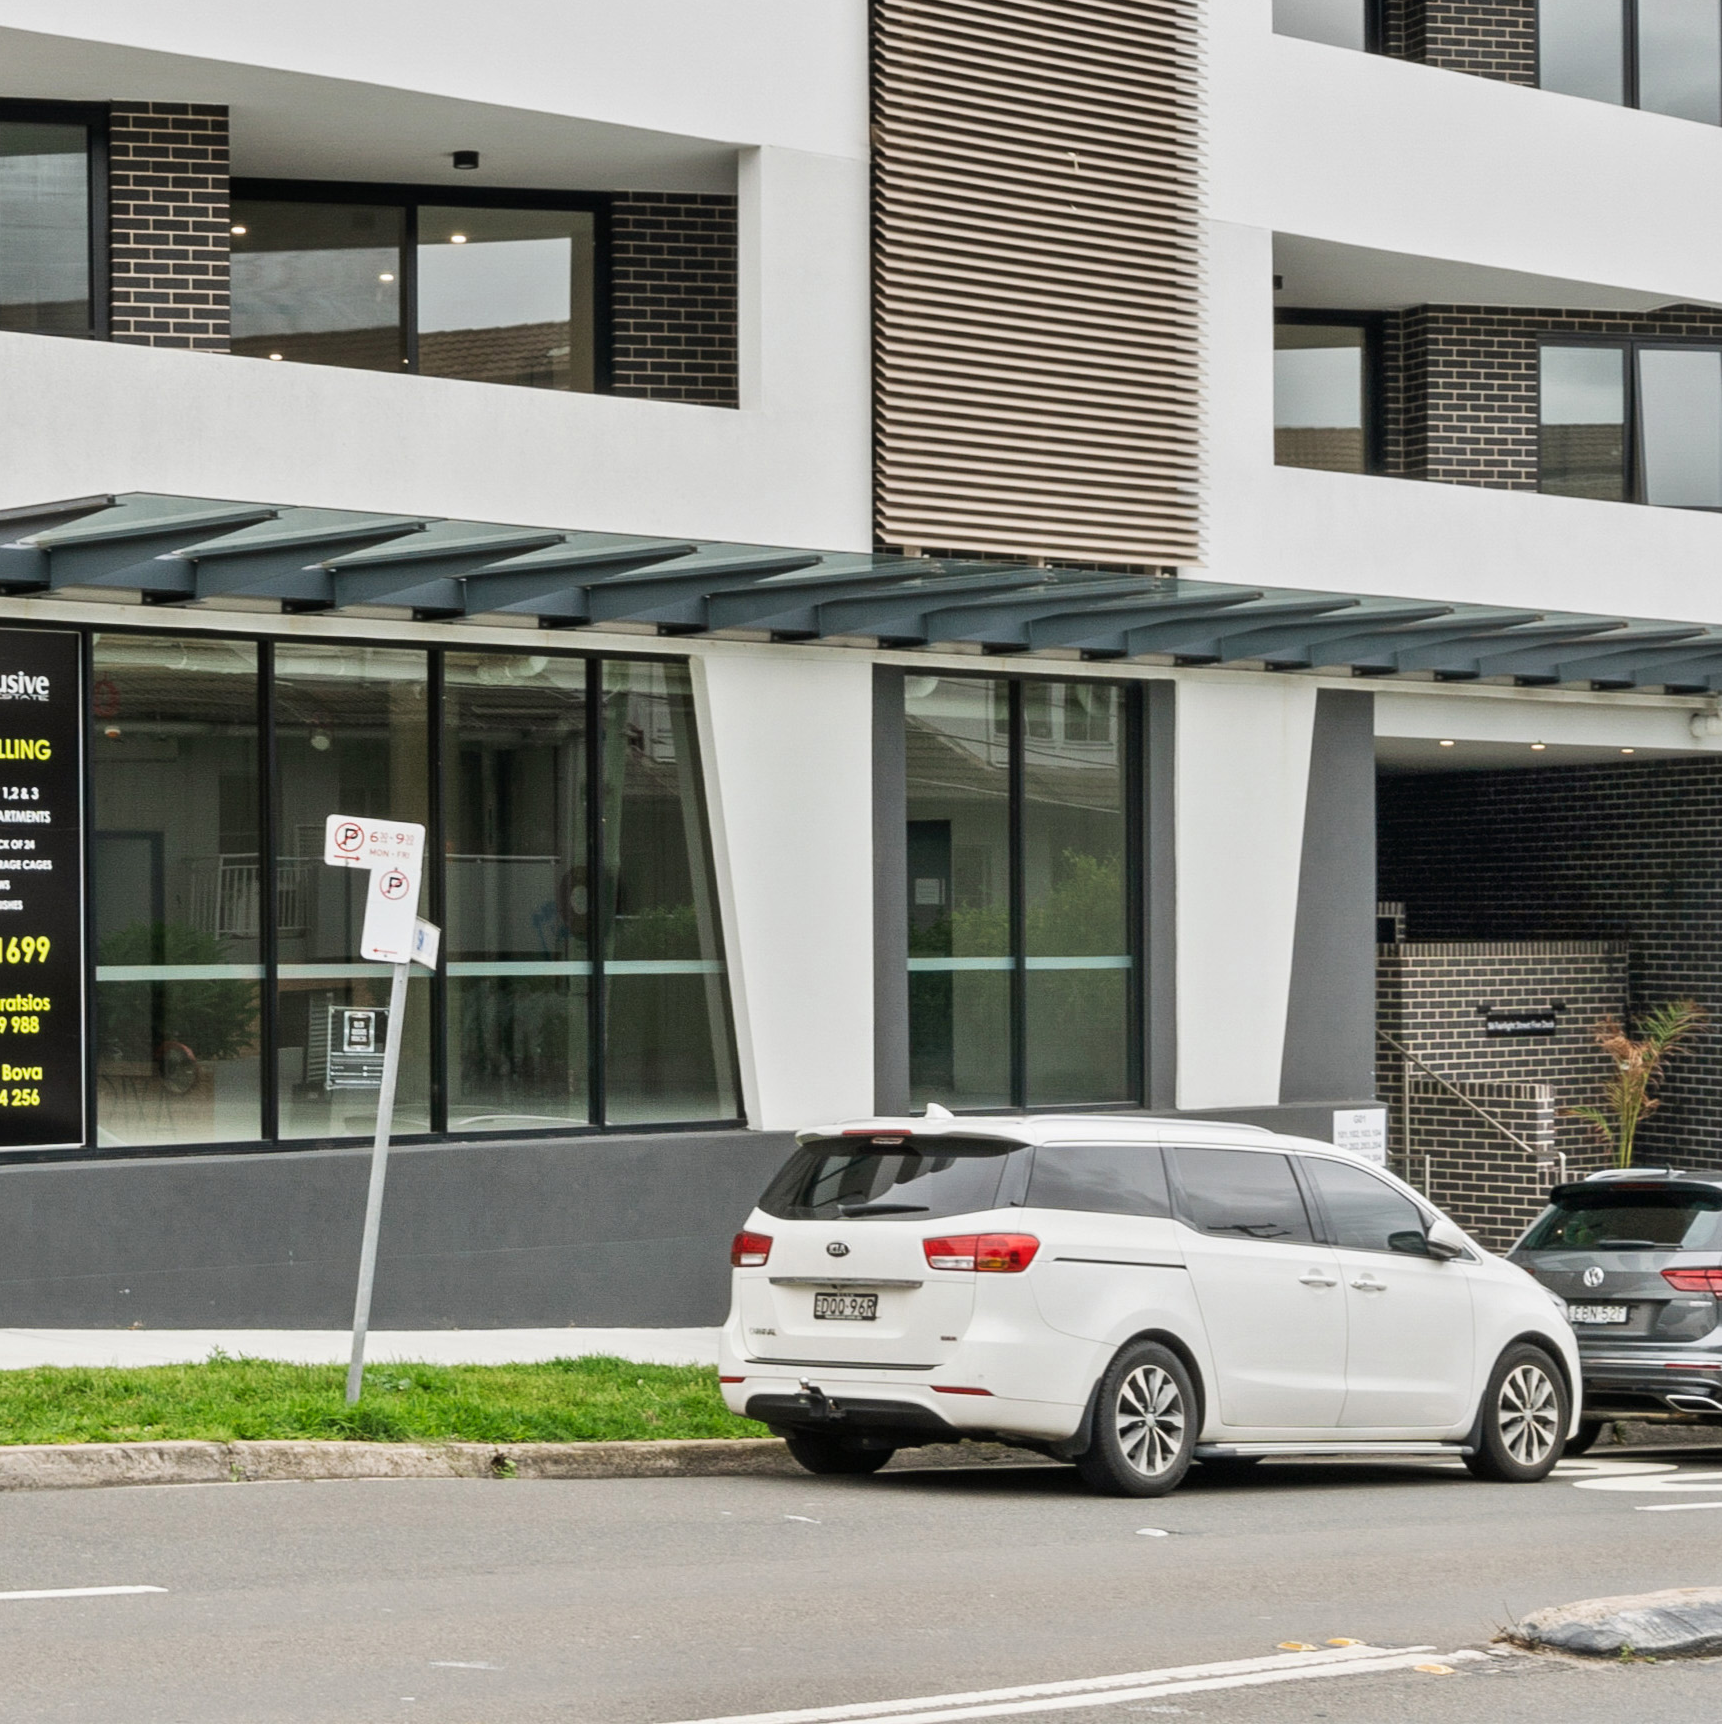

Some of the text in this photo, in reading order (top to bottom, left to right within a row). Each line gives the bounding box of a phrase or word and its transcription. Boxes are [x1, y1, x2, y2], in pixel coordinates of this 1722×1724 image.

[2, 786, 19, 801] 1,2
[20, 787, 29, 800] &
[31, 787, 39, 800] 3
[11, 839, 23, 850] OF
[24, 839, 35, 850] 24
[22, 860, 52, 870] CAGES
[11, 1015, 40, 1034] 988
[1, 1063, 43, 1081] Bova
[11, 1088, 40, 1106] 256
[829, 1245, 847, 1254] KIA
